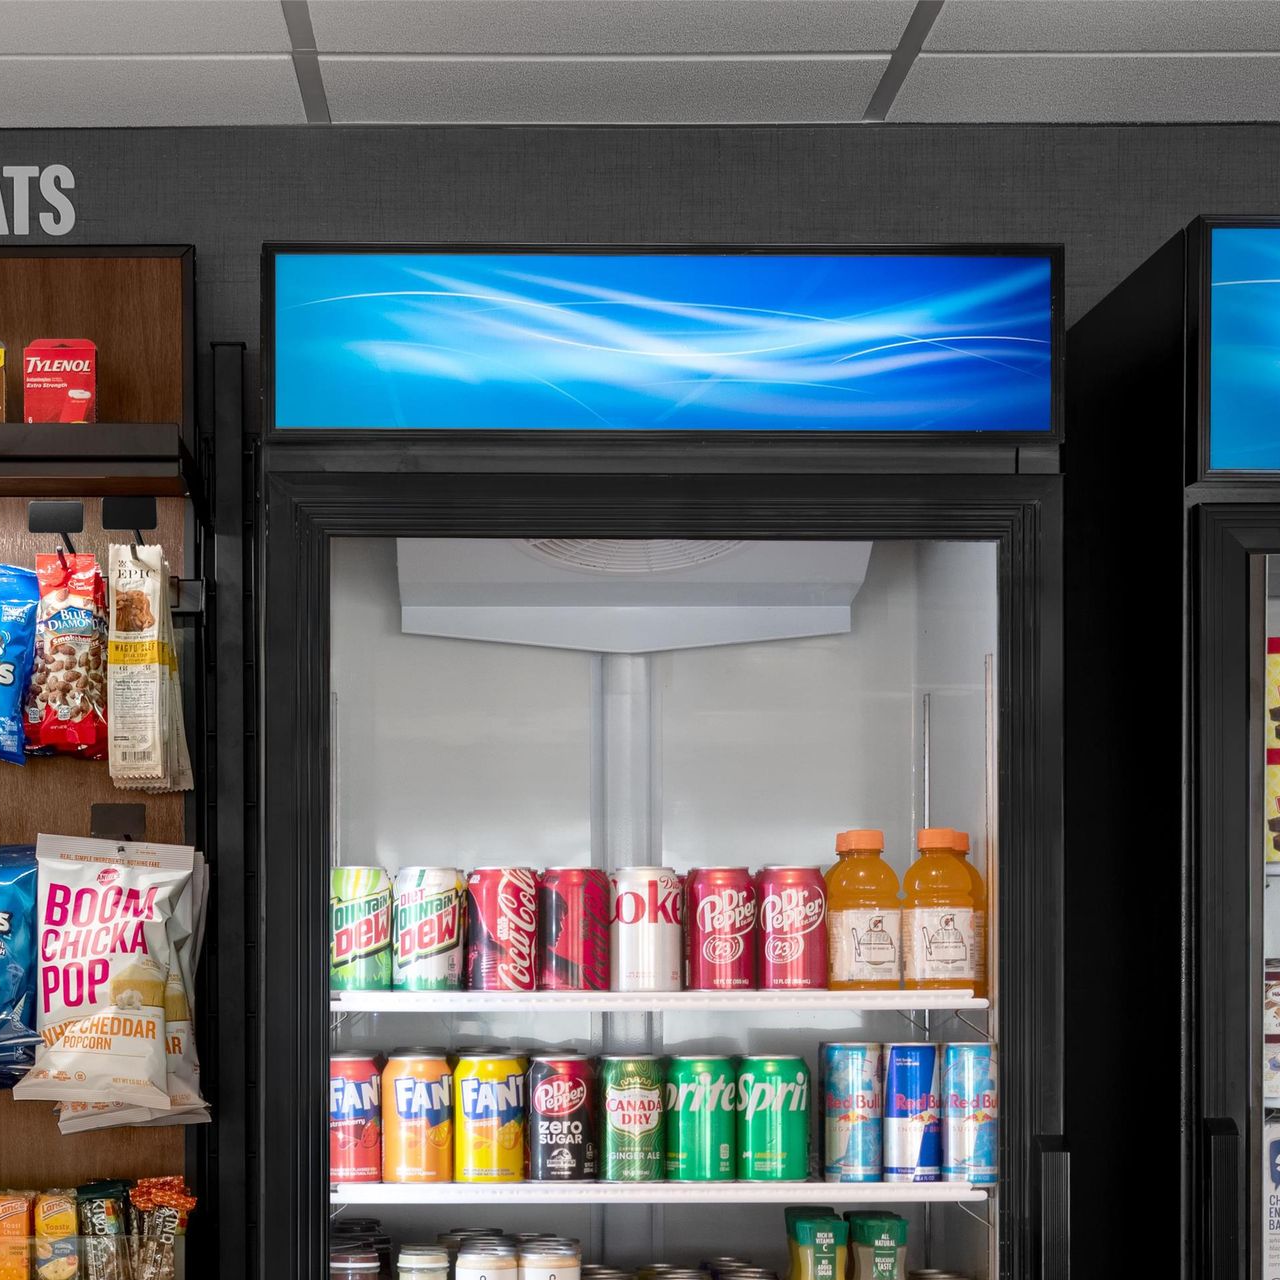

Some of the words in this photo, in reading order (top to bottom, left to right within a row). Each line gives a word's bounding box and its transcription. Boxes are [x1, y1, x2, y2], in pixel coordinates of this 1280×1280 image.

[26, 357, 91, 373] TYLENOL
[60, 608, 87, 621] BLUE
[44, 882, 158, 928] BOOM
[400, 889, 425, 906] DIET
[765, 893, 822, 934] Pepper
[41, 920, 149, 962] CHICKA
[714, 941, 733, 956] 23
[42, 958, 110, 1013] POP
[79, 1017, 156, 1039] CHEDDAR
[62, 1037, 112, 1050] POPCORN
[606, 1098, 663, 1114] CANADA
[856, 1094, 880, 1109] Bull
[950, 1094, 980, 1108] Red
[621, 1111, 651, 1126] DRY
[539, 1120, 582, 1135] zero
[640, 1151, 660, 1160] ALE
[875, 1239, 896, 1247] NATURAL
